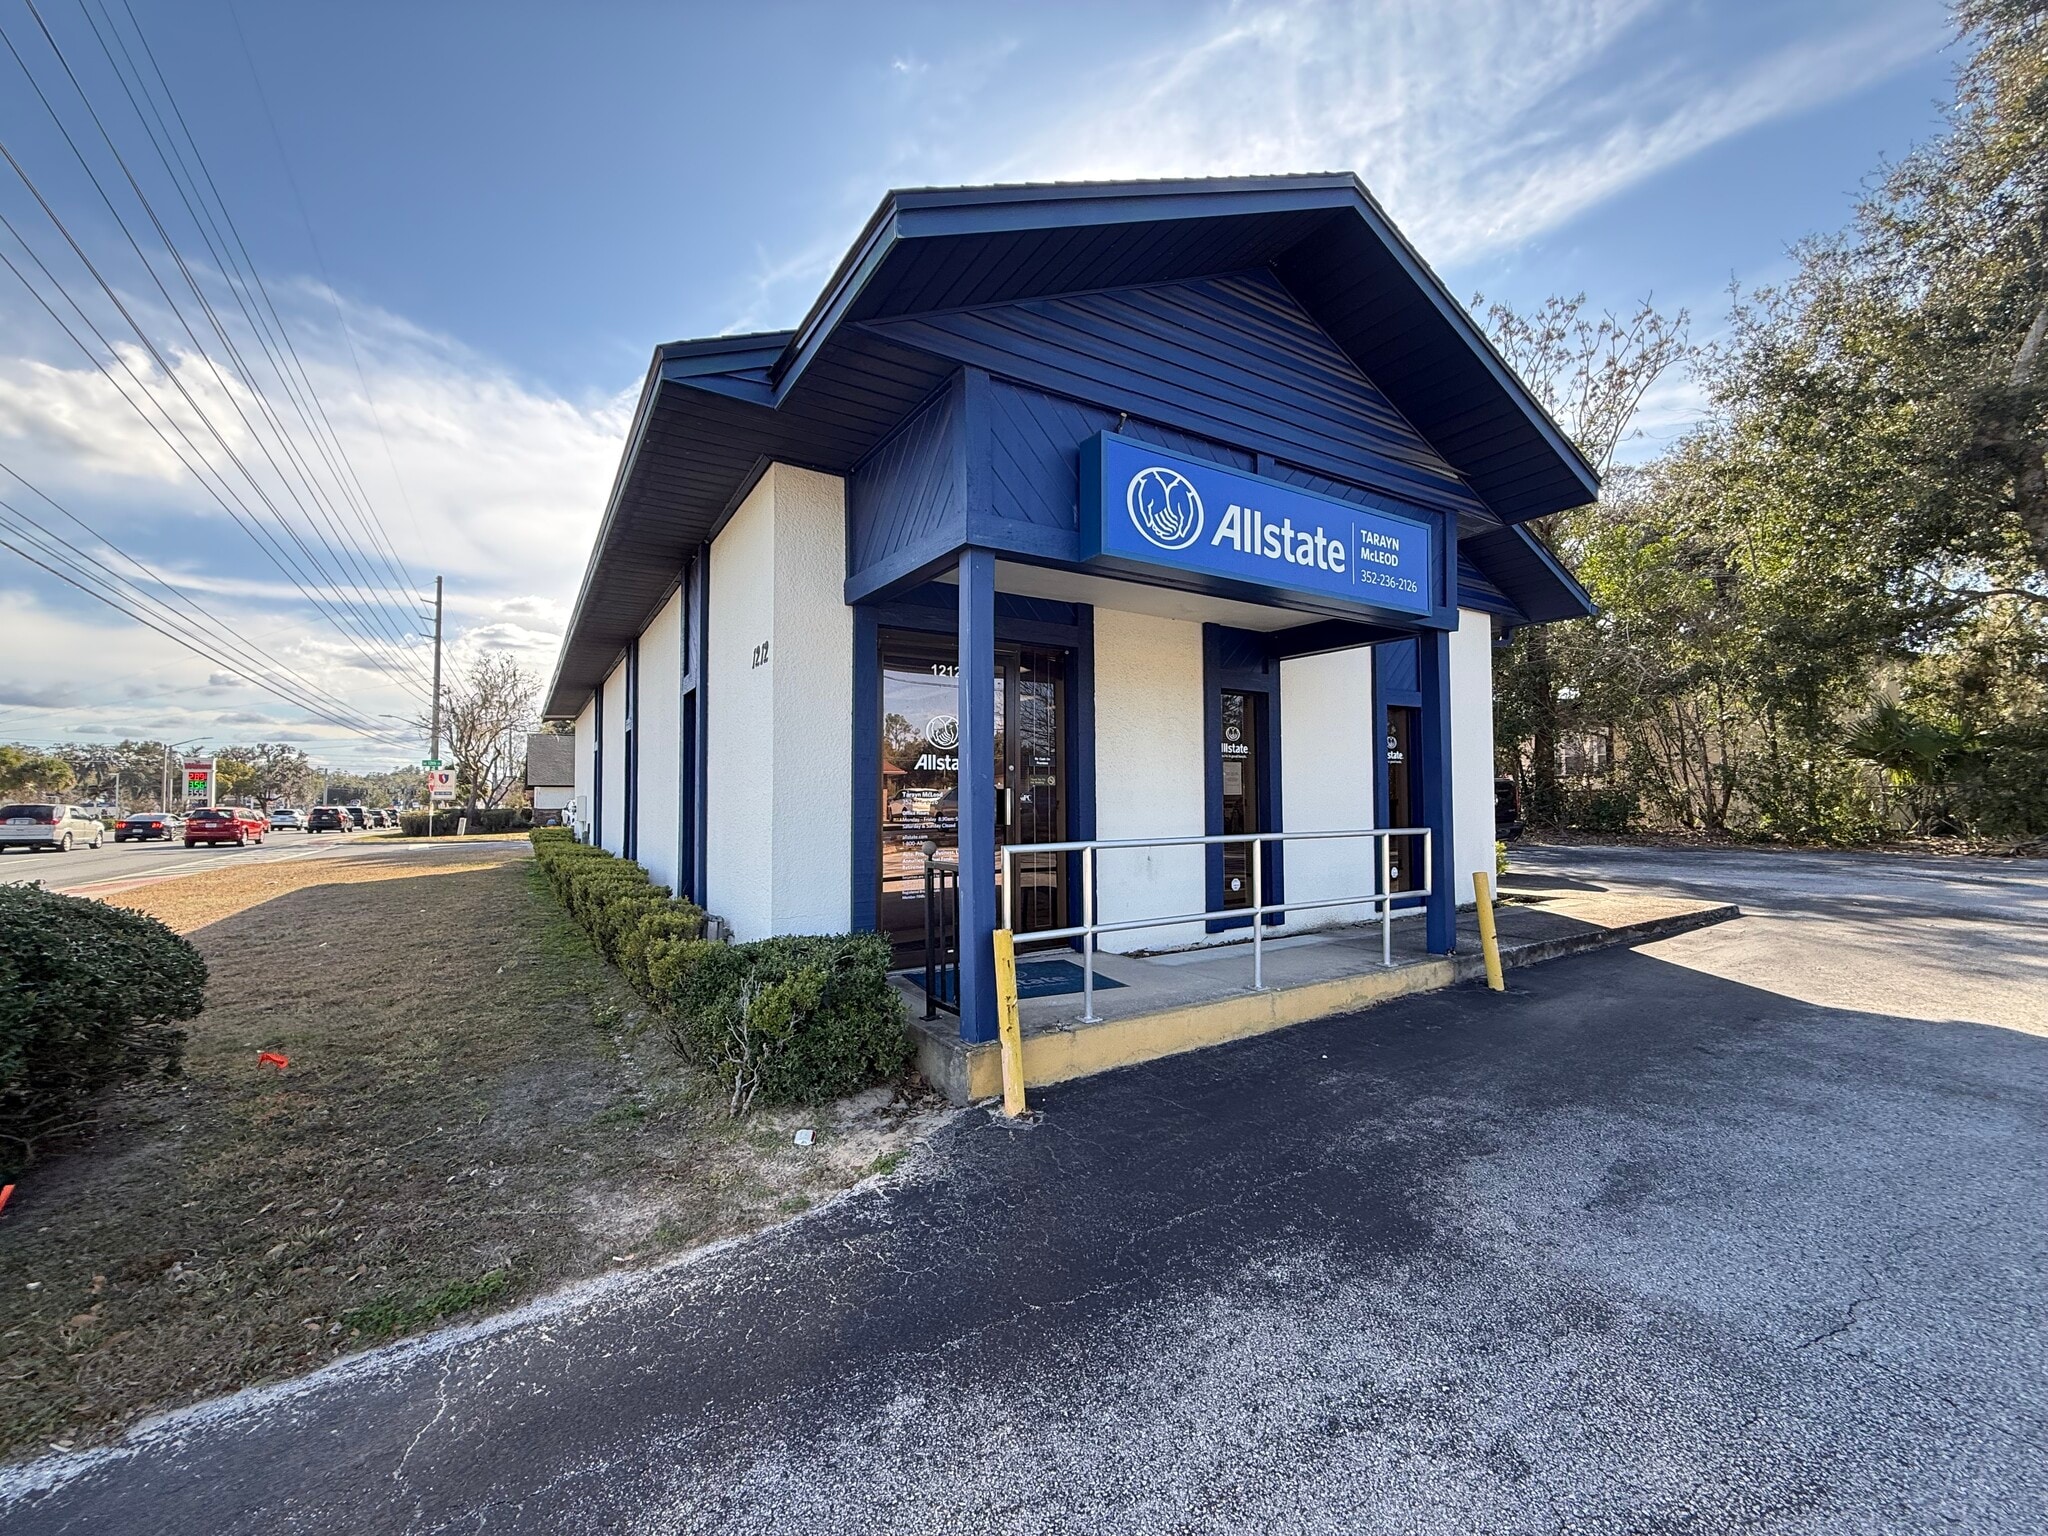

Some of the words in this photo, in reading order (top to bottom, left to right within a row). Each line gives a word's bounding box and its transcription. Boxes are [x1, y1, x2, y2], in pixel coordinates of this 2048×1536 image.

[1211, 504, 1346, 573] Allstate
[1360, 529, 1399, 551] TARAYN
[1360, 547, 1399, 567] McLEOD
[1360, 569, 1418, 593] 352-236-2126
[752, 640, 769, 669] 1212
[931, 664, 959, 678] 1212
[1220, 742, 1249, 754] llstate
[1387, 750, 1404, 760] state
[913, 754, 959, 771] Allsta
